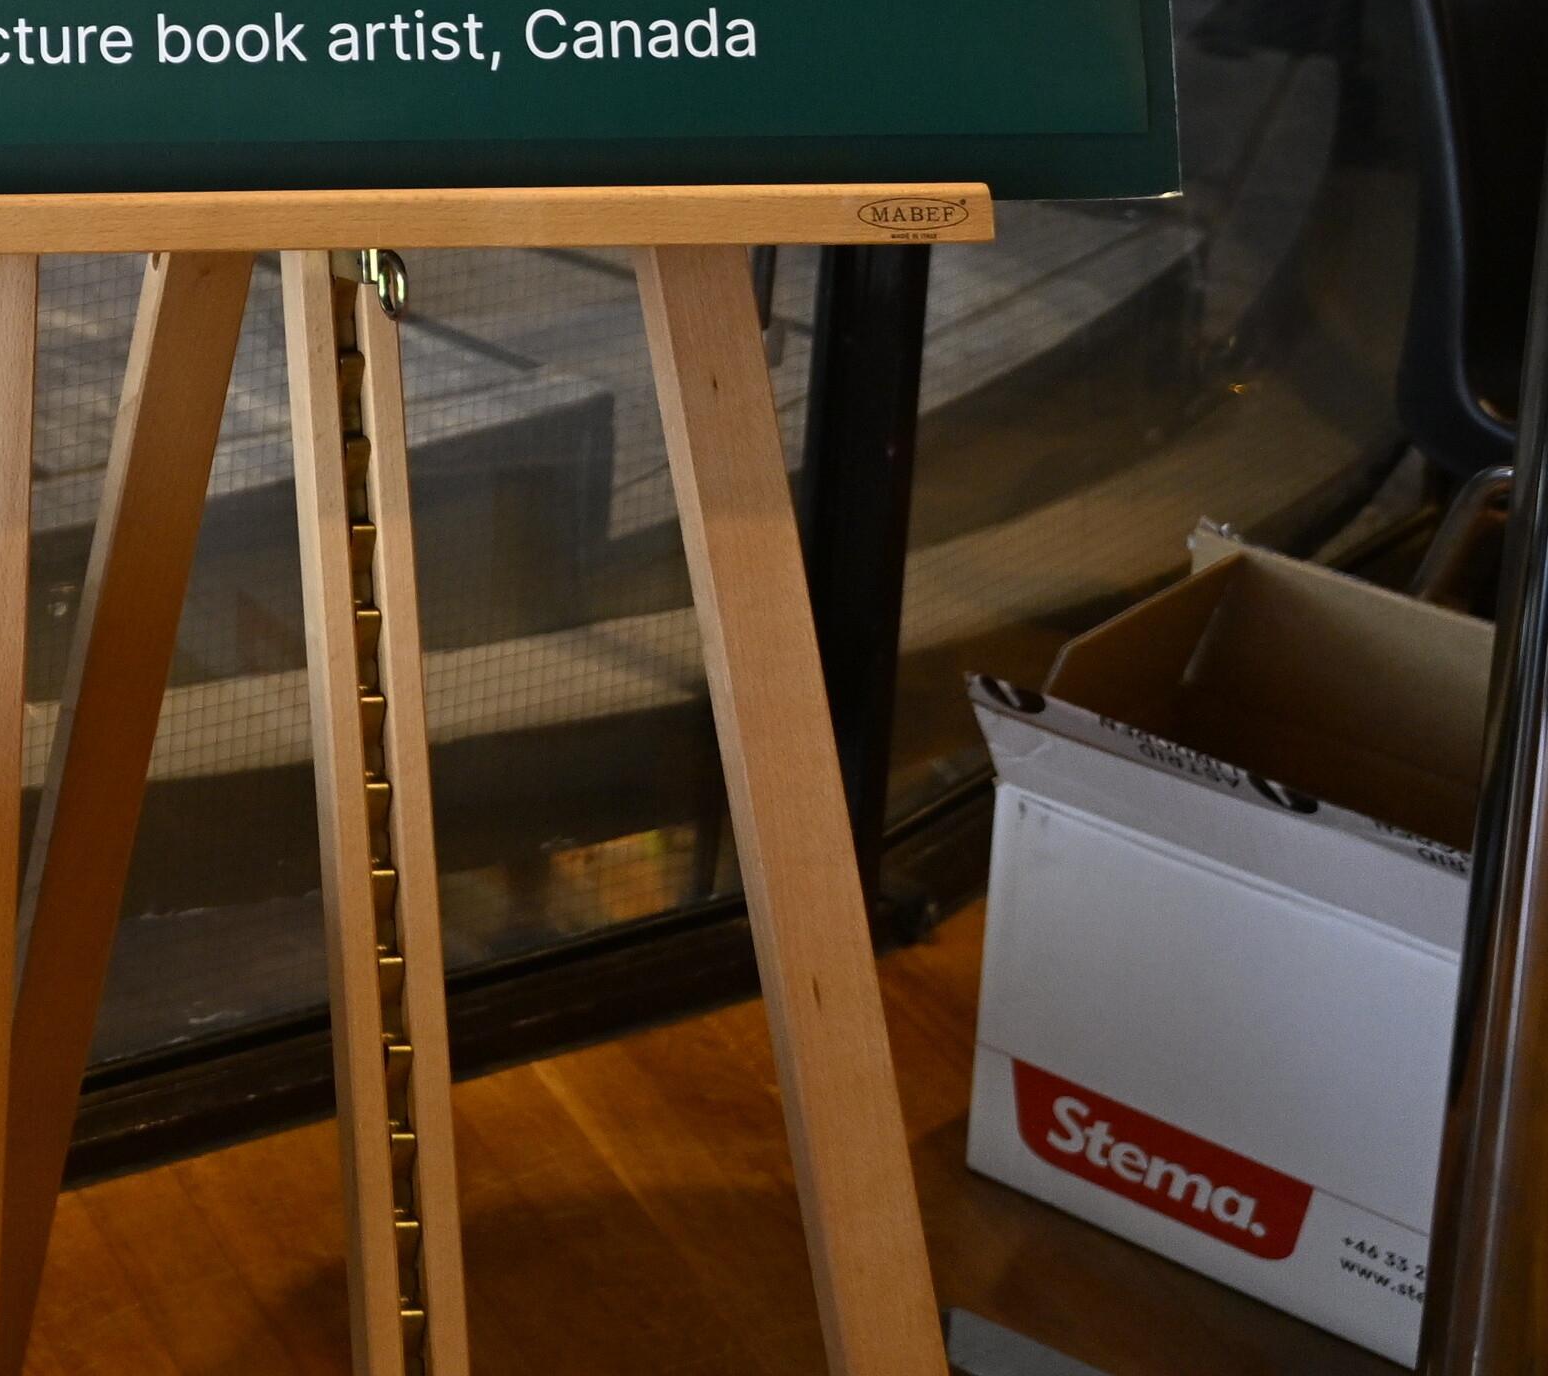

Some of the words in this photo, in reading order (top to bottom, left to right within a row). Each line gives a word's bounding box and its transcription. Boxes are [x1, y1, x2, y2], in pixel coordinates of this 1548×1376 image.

[157, 11, 308, 64] book
[328, 9, 501, 71] artist,
[525, 7, 756, 60] Canada
[871, 206, 956, 223] MABEF
[1045, 1093, 1268, 1240] Stema.
